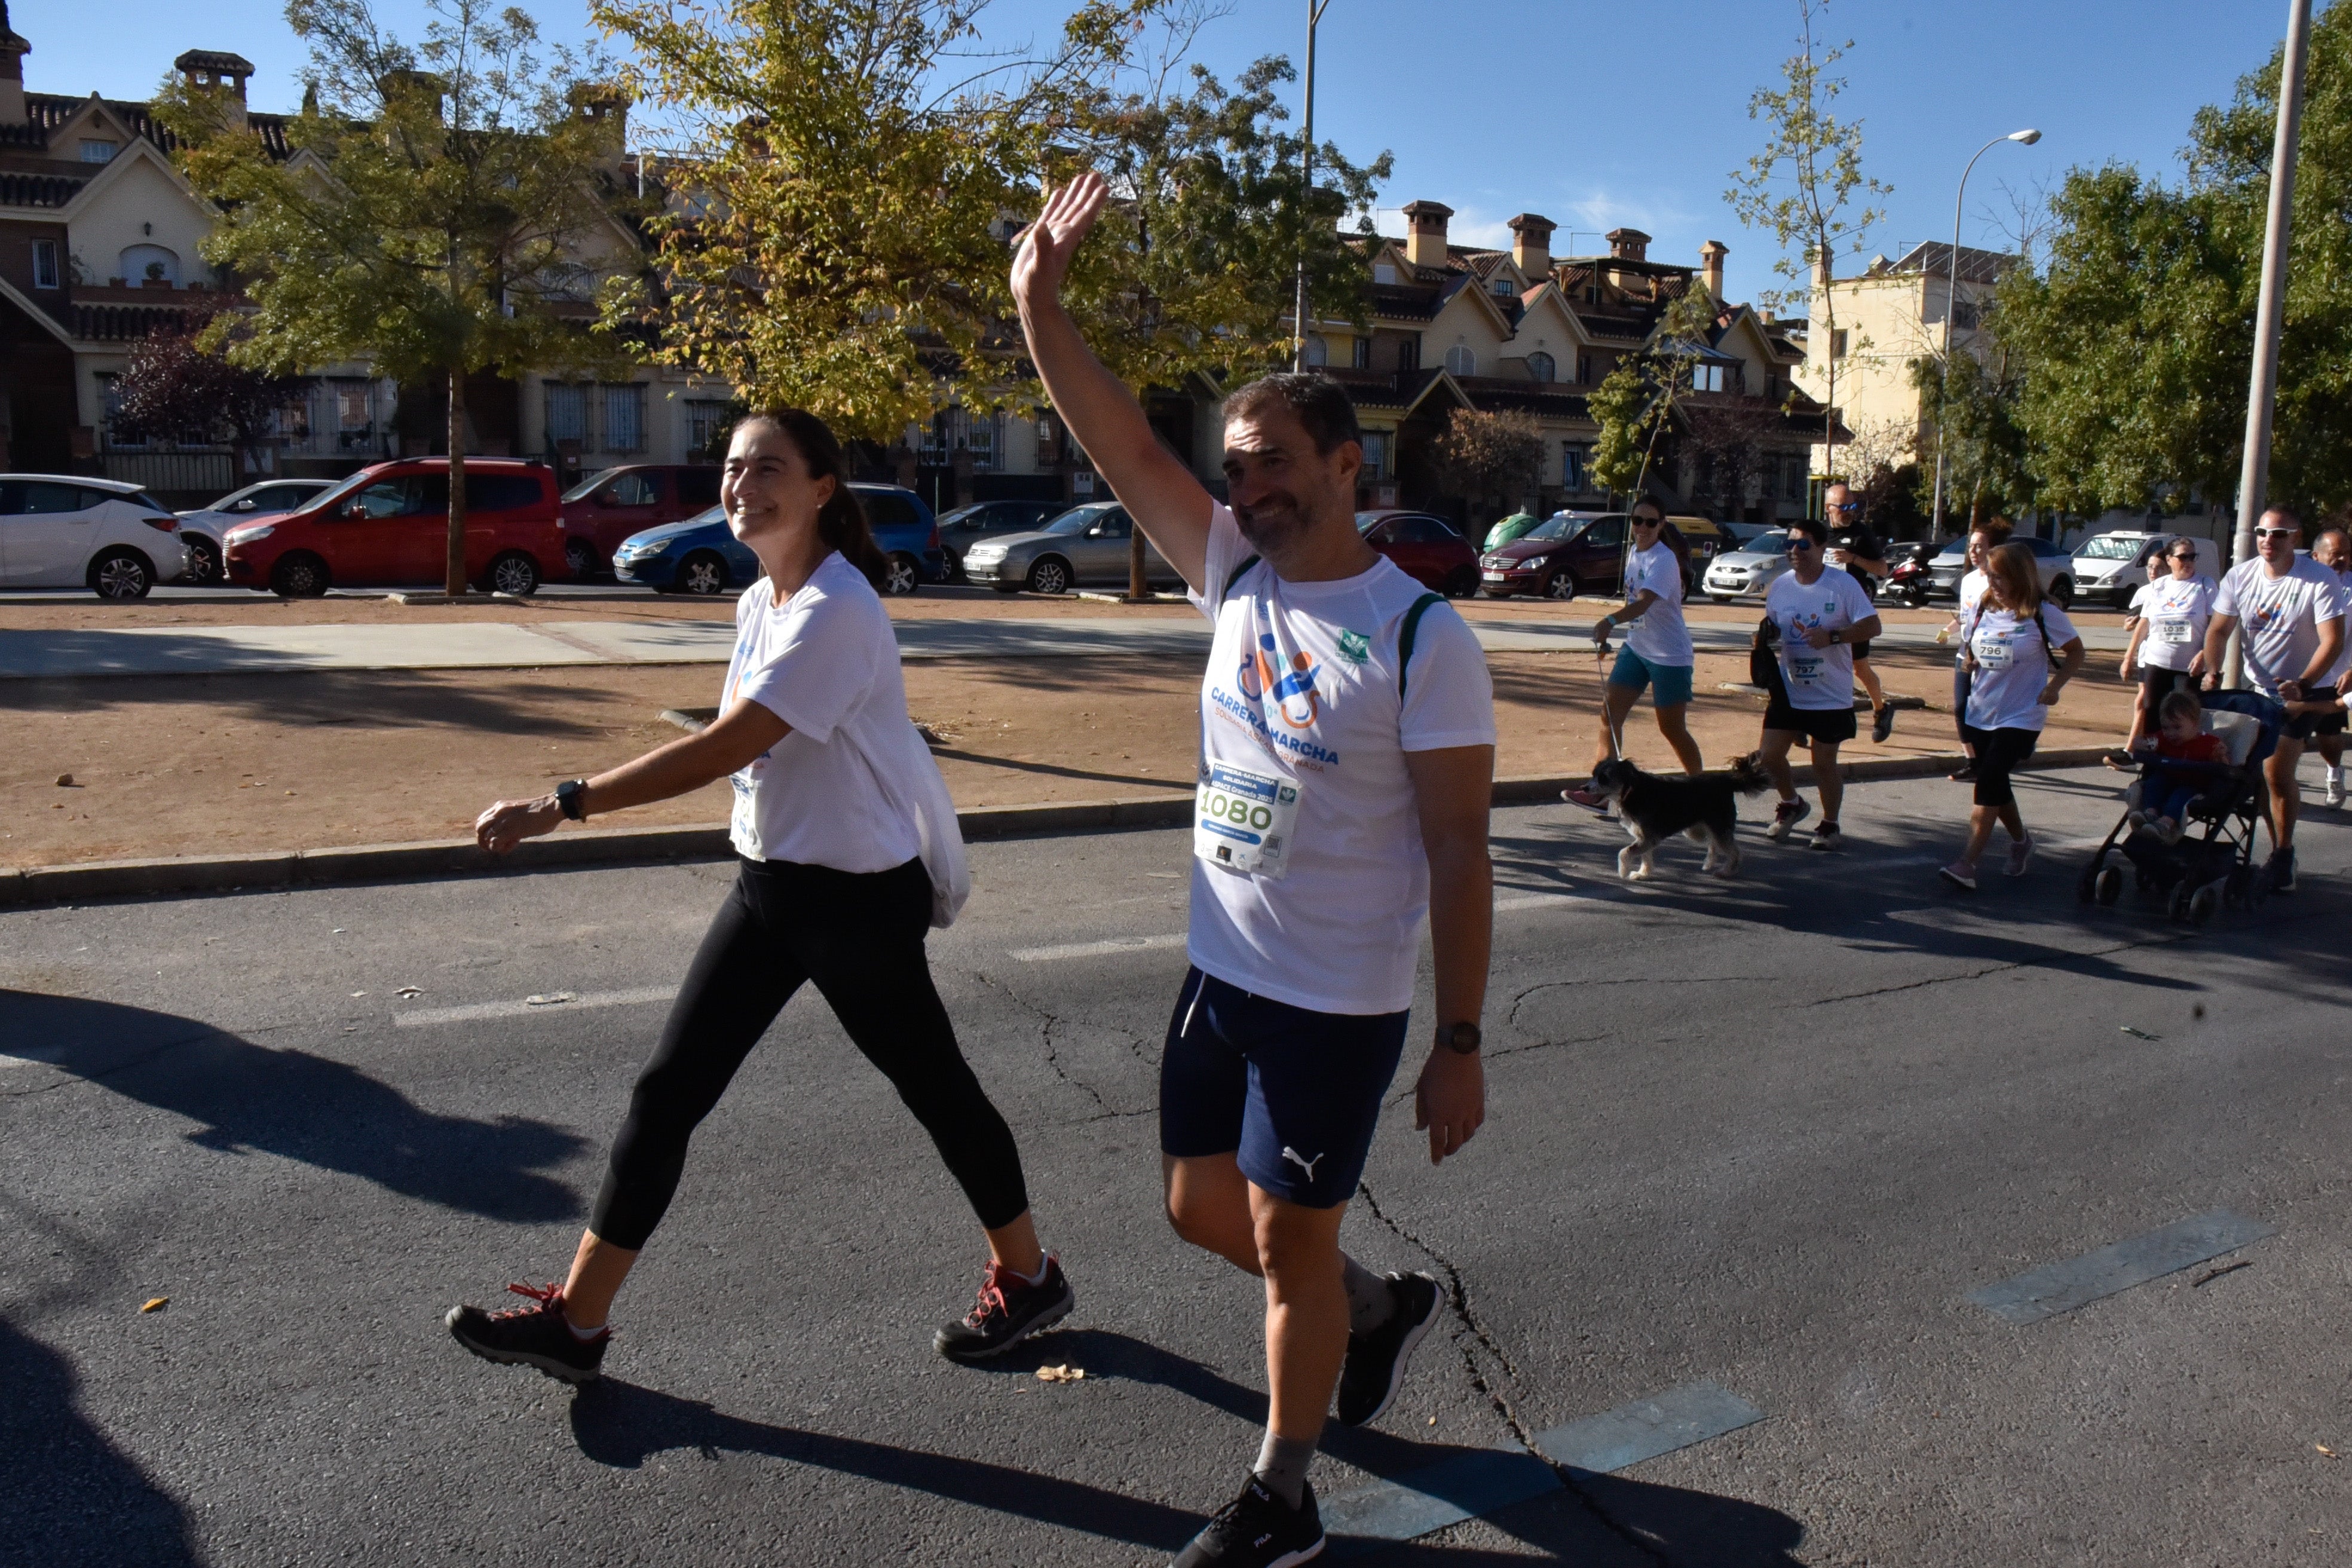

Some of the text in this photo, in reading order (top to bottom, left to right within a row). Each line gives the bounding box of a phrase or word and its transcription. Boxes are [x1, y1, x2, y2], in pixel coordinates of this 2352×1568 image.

[1980, 646, 2001, 655] 796
[1278, 751, 1324, 773] GRANADA
[1223, 775, 1257, 789] SOLIDARIA
[1211, 780, 1273, 803] ASPACE Granada 2025
[1200, 790, 1272, 830] 1080
[1254, 1533, 1272, 1548] FILA
